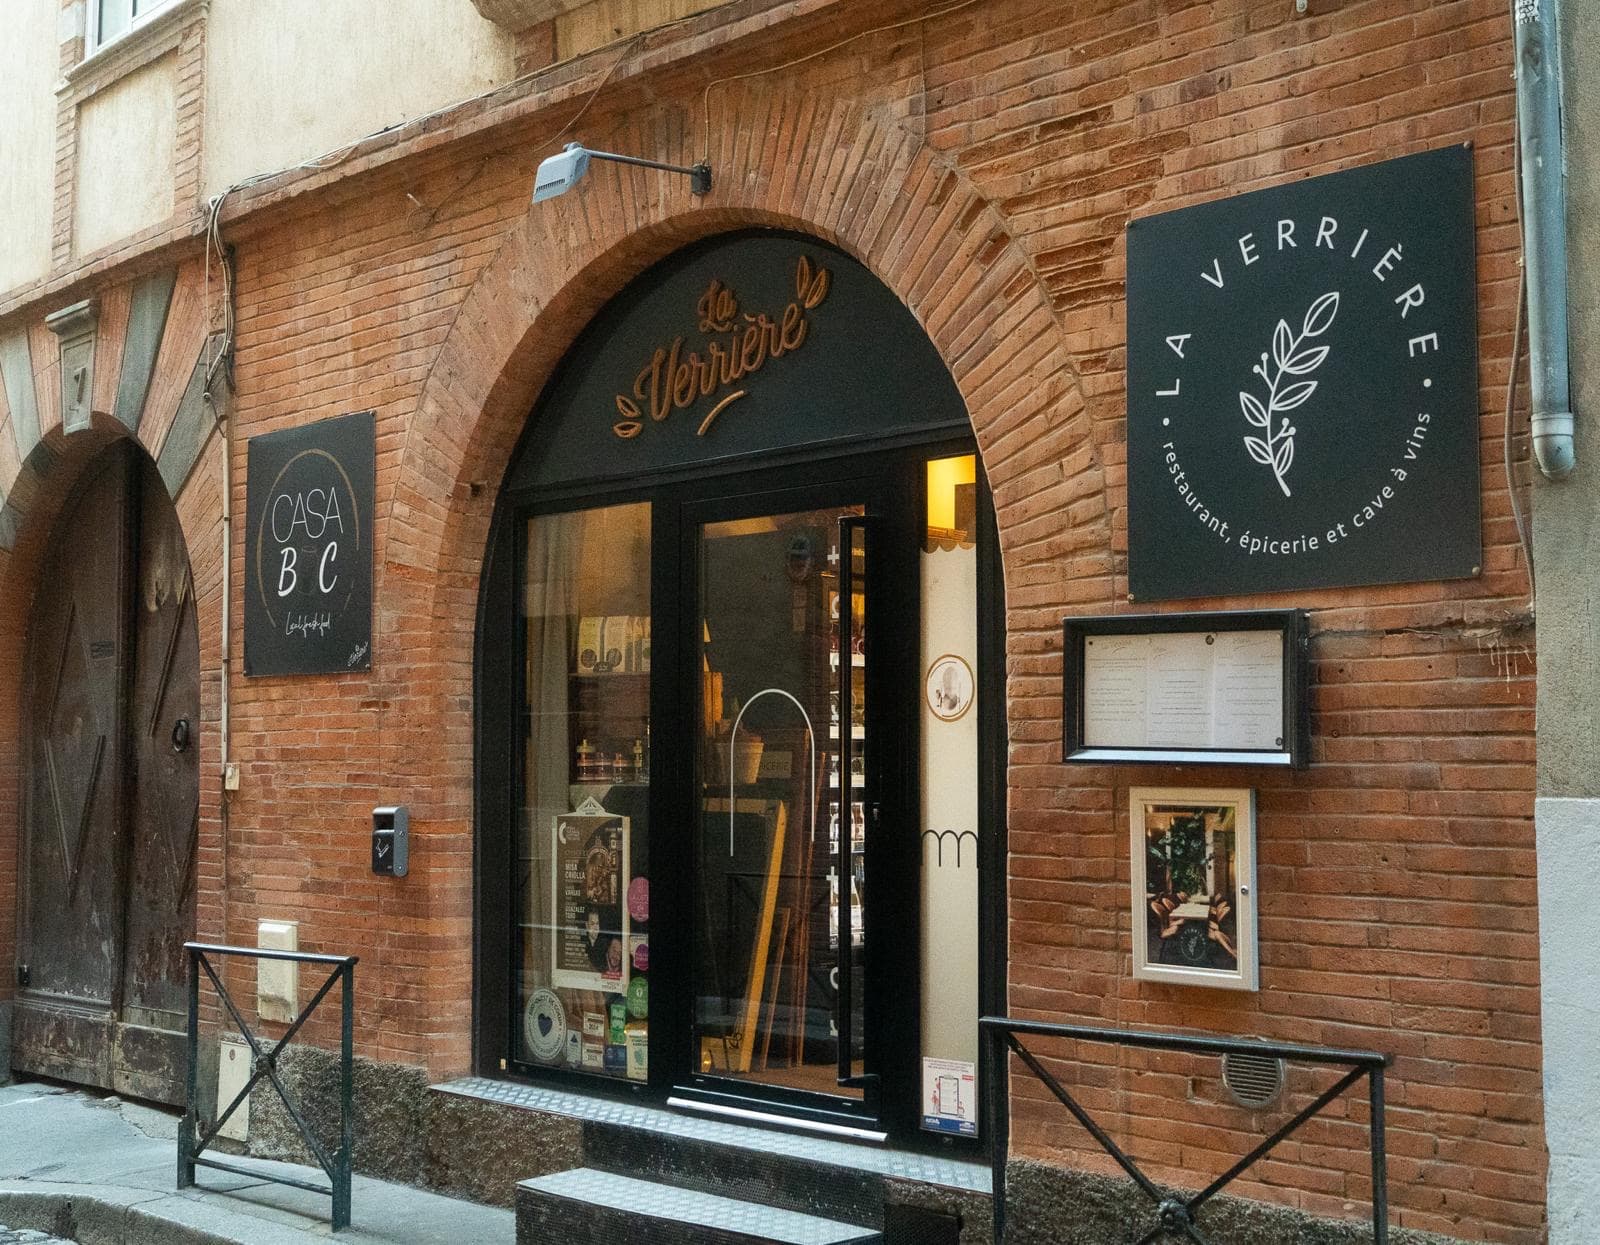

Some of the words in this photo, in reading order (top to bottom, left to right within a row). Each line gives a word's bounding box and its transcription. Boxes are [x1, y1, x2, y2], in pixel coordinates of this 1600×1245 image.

[698, 279, 737, 332] La
[1156, 332, 1191, 397] LA
[1200, 216, 1439, 358] VERRIÈRE
[633, 303, 808, 421] Verrière
[271, 487, 344, 543] CASA
[1162, 441, 1231, 544] restaurant,
[1239, 530, 1320, 555] épicerie
[1326, 522, 1348, 543] et
[1352, 486, 1395, 527] cave
[1389, 468, 1408, 481] à
[1403, 412, 1431, 460] vins
[277, 547, 298, 597] B
[318, 541, 338, 594] C
